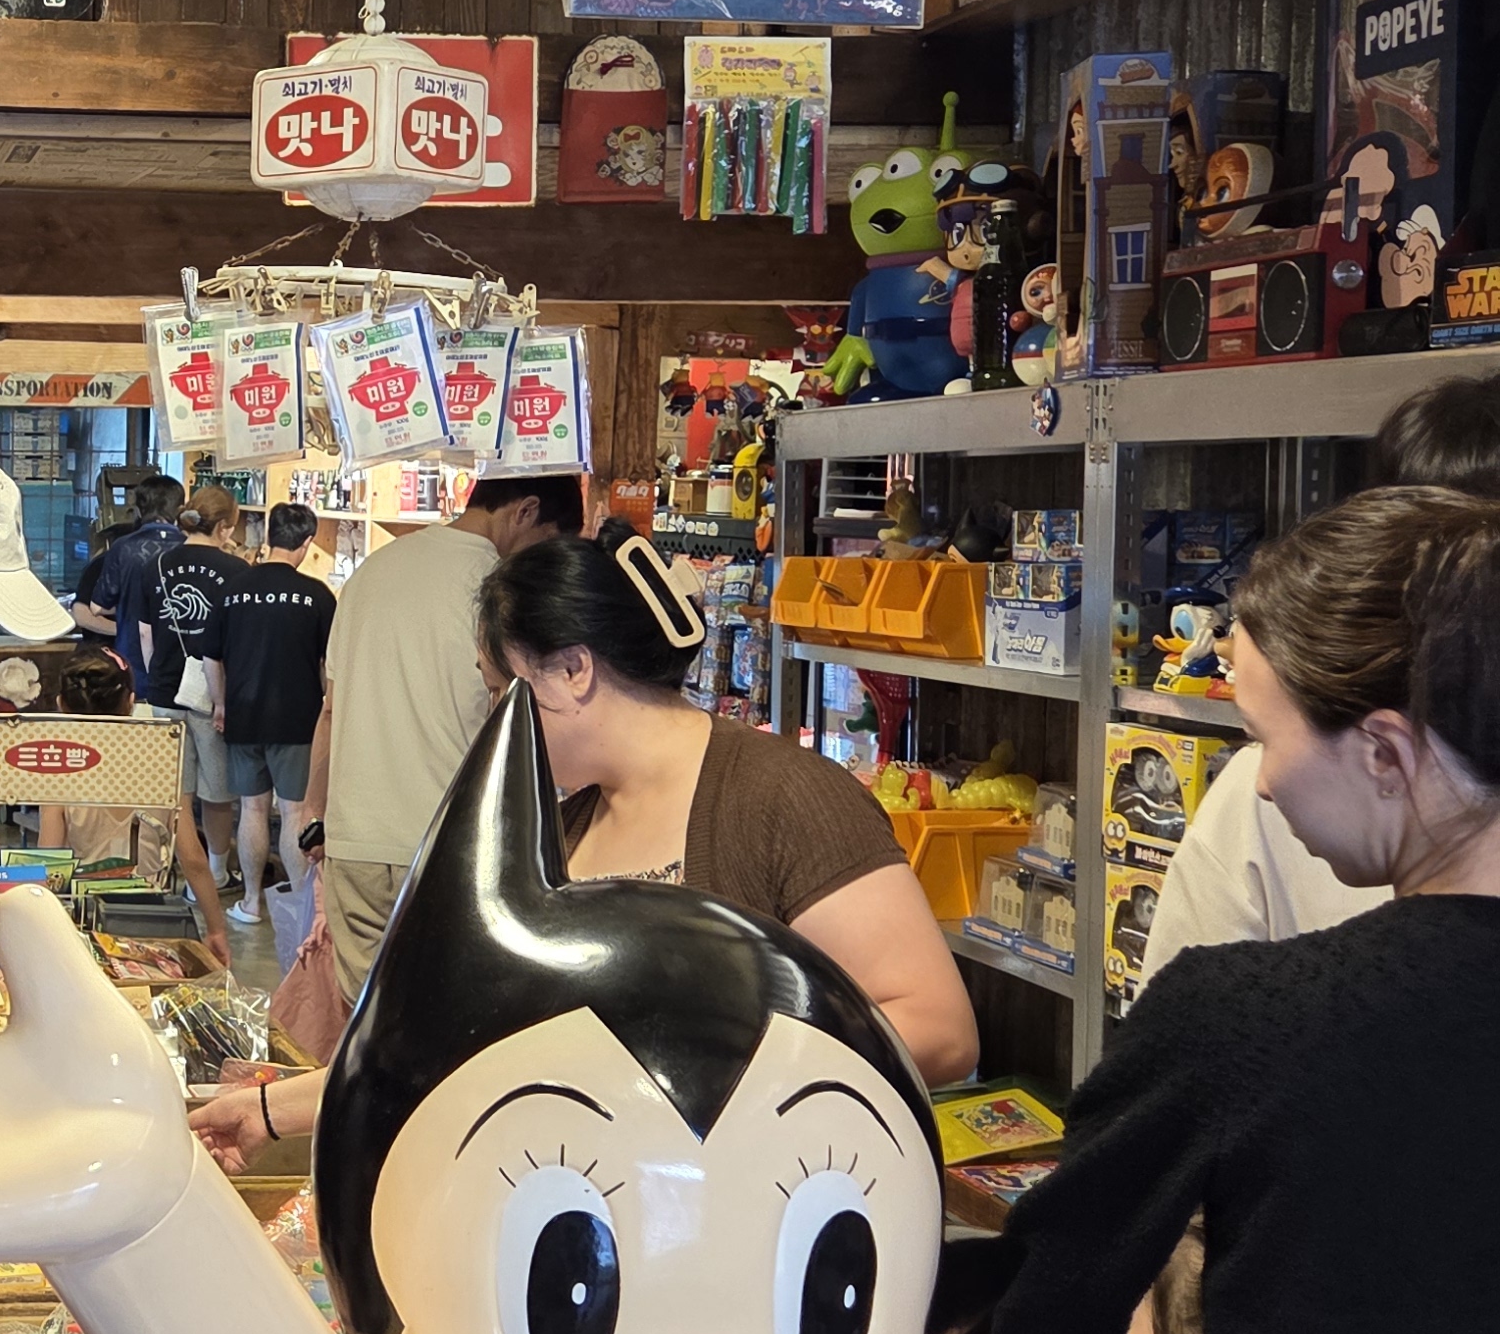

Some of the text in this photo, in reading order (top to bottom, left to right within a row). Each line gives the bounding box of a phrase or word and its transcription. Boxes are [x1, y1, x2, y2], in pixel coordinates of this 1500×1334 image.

[278, 107, 360, 158] 맛나
[411, 108, 472, 160] 맛나
[244, 385, 277, 407] 미원
[365, 376, 407, 404] 미원
[513, 396, 551, 417] 미원
